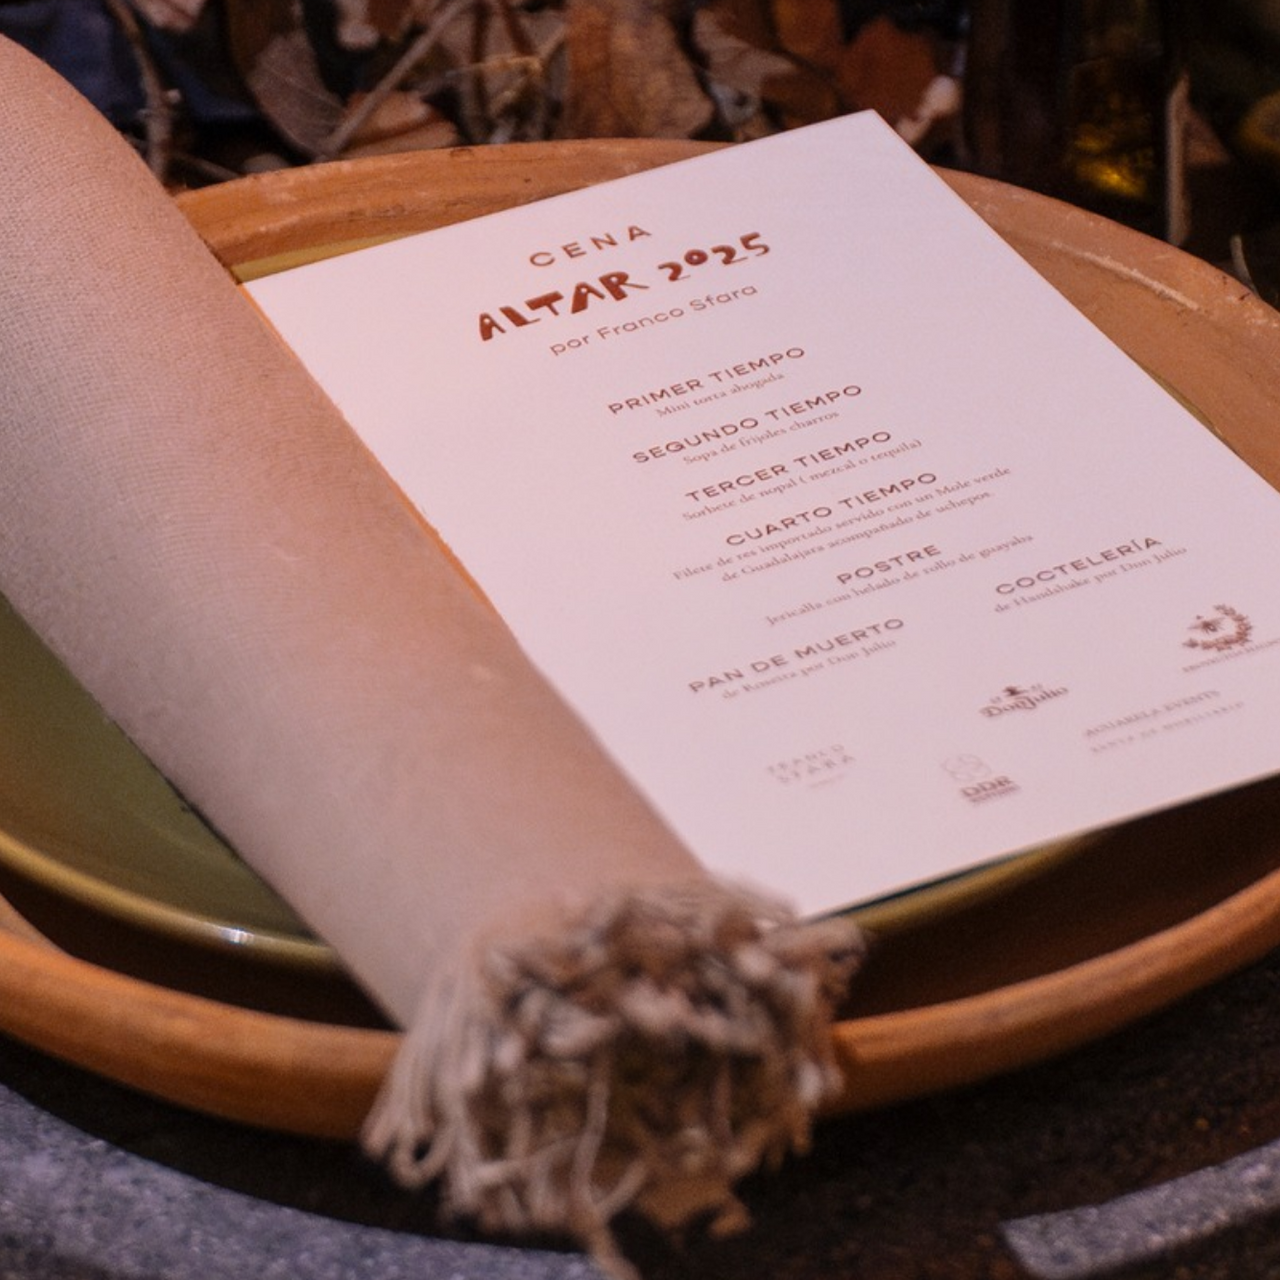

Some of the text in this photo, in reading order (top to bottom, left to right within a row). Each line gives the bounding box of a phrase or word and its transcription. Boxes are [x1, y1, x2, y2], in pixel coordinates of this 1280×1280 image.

[529, 225, 652, 267] CENA
[478, 231, 770, 342] ALTAR 2025
[549, 284, 758, 356] por Franco Sfara
[608, 347, 806, 416] PRIMER TIEMPO
[656, 373, 785, 418] Mini torta ahogada
[632, 385, 862, 463] SEGUNDO TIEMPO
[683, 411, 840, 466] Sopa de frijoles charros
[681, 499, 735, 522] Sorbete
[739, 490, 756, 503] de
[759, 479, 799, 501] nopal
[808, 460, 856, 482] mezcal
[685, 431, 891, 503] TERCER TIEMPO
[672, 466, 1012, 581] Filete de res importado servido con un Mole verde
[726, 473, 937, 546] CUARTO TIEMPO
[721, 569, 739, 583] de
[741, 543, 825, 576] Guadalajara
[827, 512, 913, 549] acompañado
[916, 509, 932, 521] de
[765, 601, 823, 626] Jericalla
[826, 591, 851, 605] con
[851, 574, 901, 597] helado
[902, 568, 920, 581] de
[958, 550, 976, 564] de
[978, 532, 1034, 560] guayaba
[836, 545, 941, 585] POSTRE
[994, 546, 1187, 614] de Handshake por Don Julio
[996, 537, 1162, 595] COCTELERÍA
[688, 619, 904, 692] PAN DE MUERTO
[721, 687, 740, 700] de
